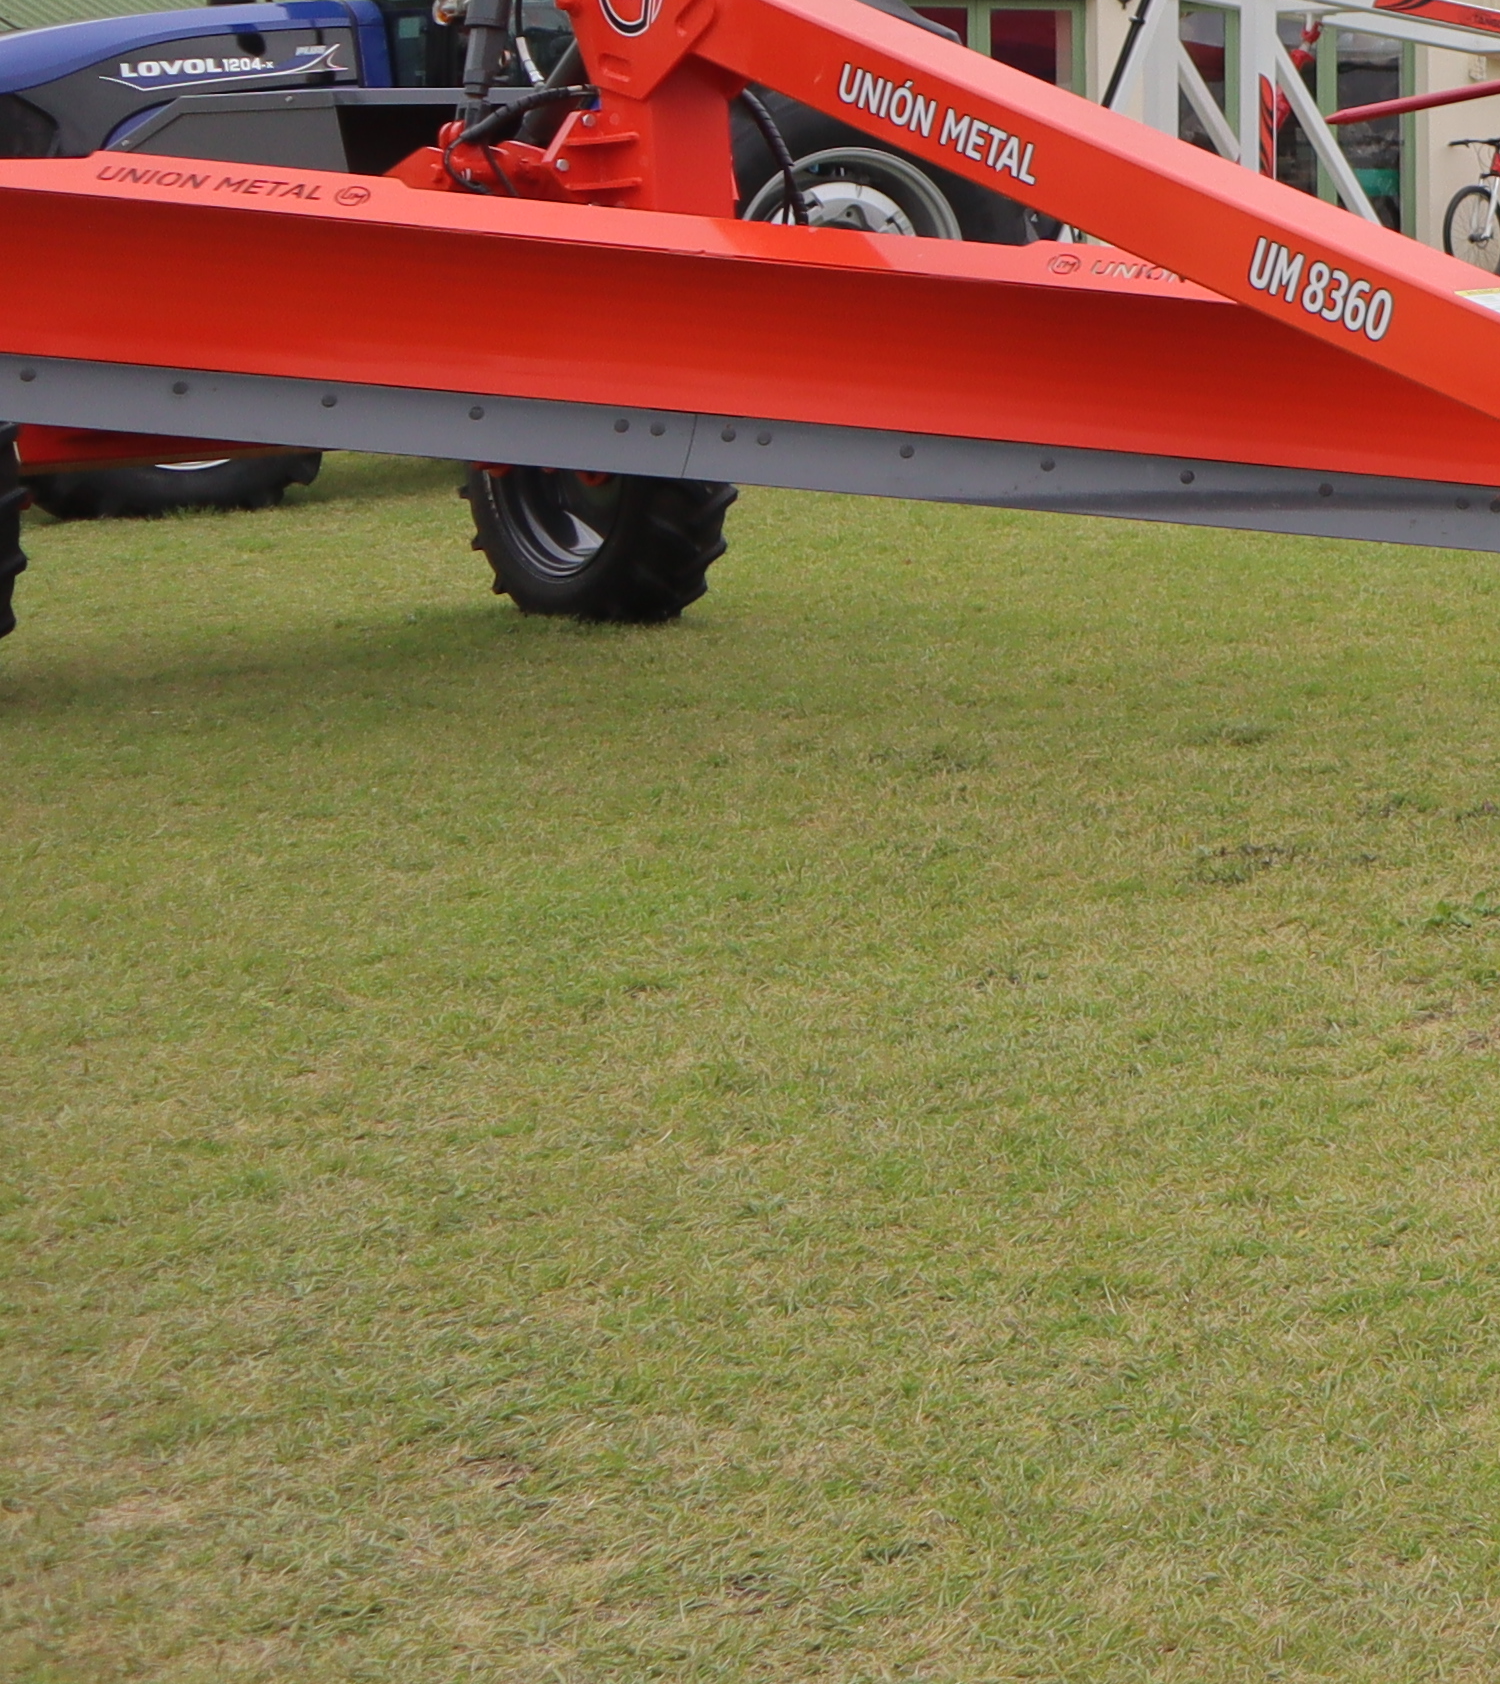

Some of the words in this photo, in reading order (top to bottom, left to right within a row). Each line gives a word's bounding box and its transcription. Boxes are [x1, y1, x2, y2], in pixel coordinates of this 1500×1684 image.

[119, 58, 222, 78] LOVOL
[838, 63, 937, 138] UNIÓN
[939, 107, 1035, 186] METAL
[96, 166, 211, 190] UNION
[213, 176, 322, 201] METAL
[1249, 235, 1305, 304] UM
[1302, 260, 1394, 342] 8360
